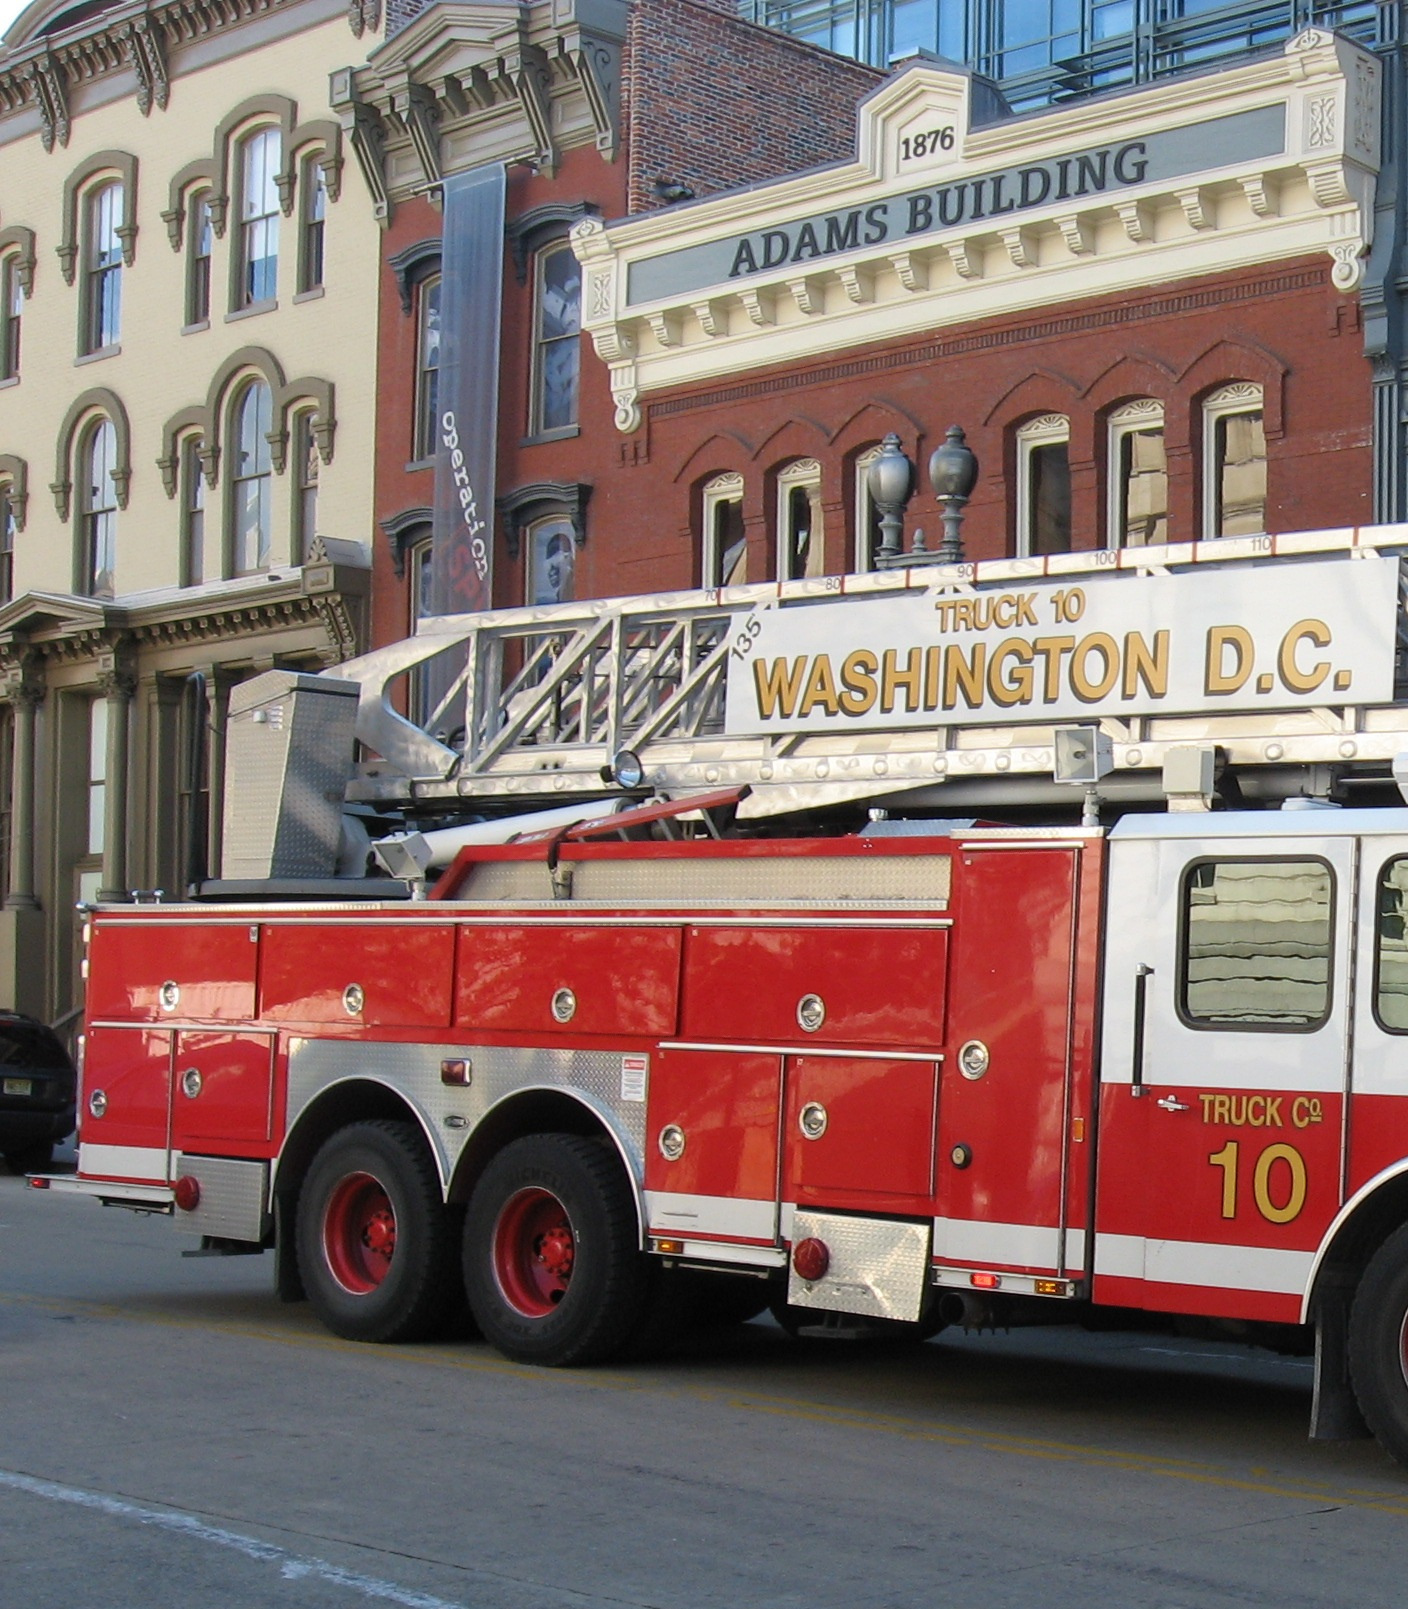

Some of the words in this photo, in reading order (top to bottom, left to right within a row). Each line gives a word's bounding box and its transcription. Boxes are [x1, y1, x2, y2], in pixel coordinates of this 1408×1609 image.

[901, 126, 955, 161] 1876
[728, 203, 890, 278] ADAMS
[905, 142, 1149, 235] BUILDING
[443, 411, 489, 581] operation
[1094, 551, 1118, 566] 100
[1251, 536, 1272, 552] 110
[449, 544, 484, 612] SP
[826, 577, 842, 591] 80
[957, 563, 974, 579] 90
[705, 589, 717, 602] 70
[935, 592, 1039, 634] TRUCK
[1051, 587, 1087, 624] 10
[752, 630, 1171, 721] WASHINGTON
[1204, 618, 1353, 698] D.C.
[1199, 1094, 1283, 1127] TRUCK
[1209, 1141, 1307, 1223] 10
